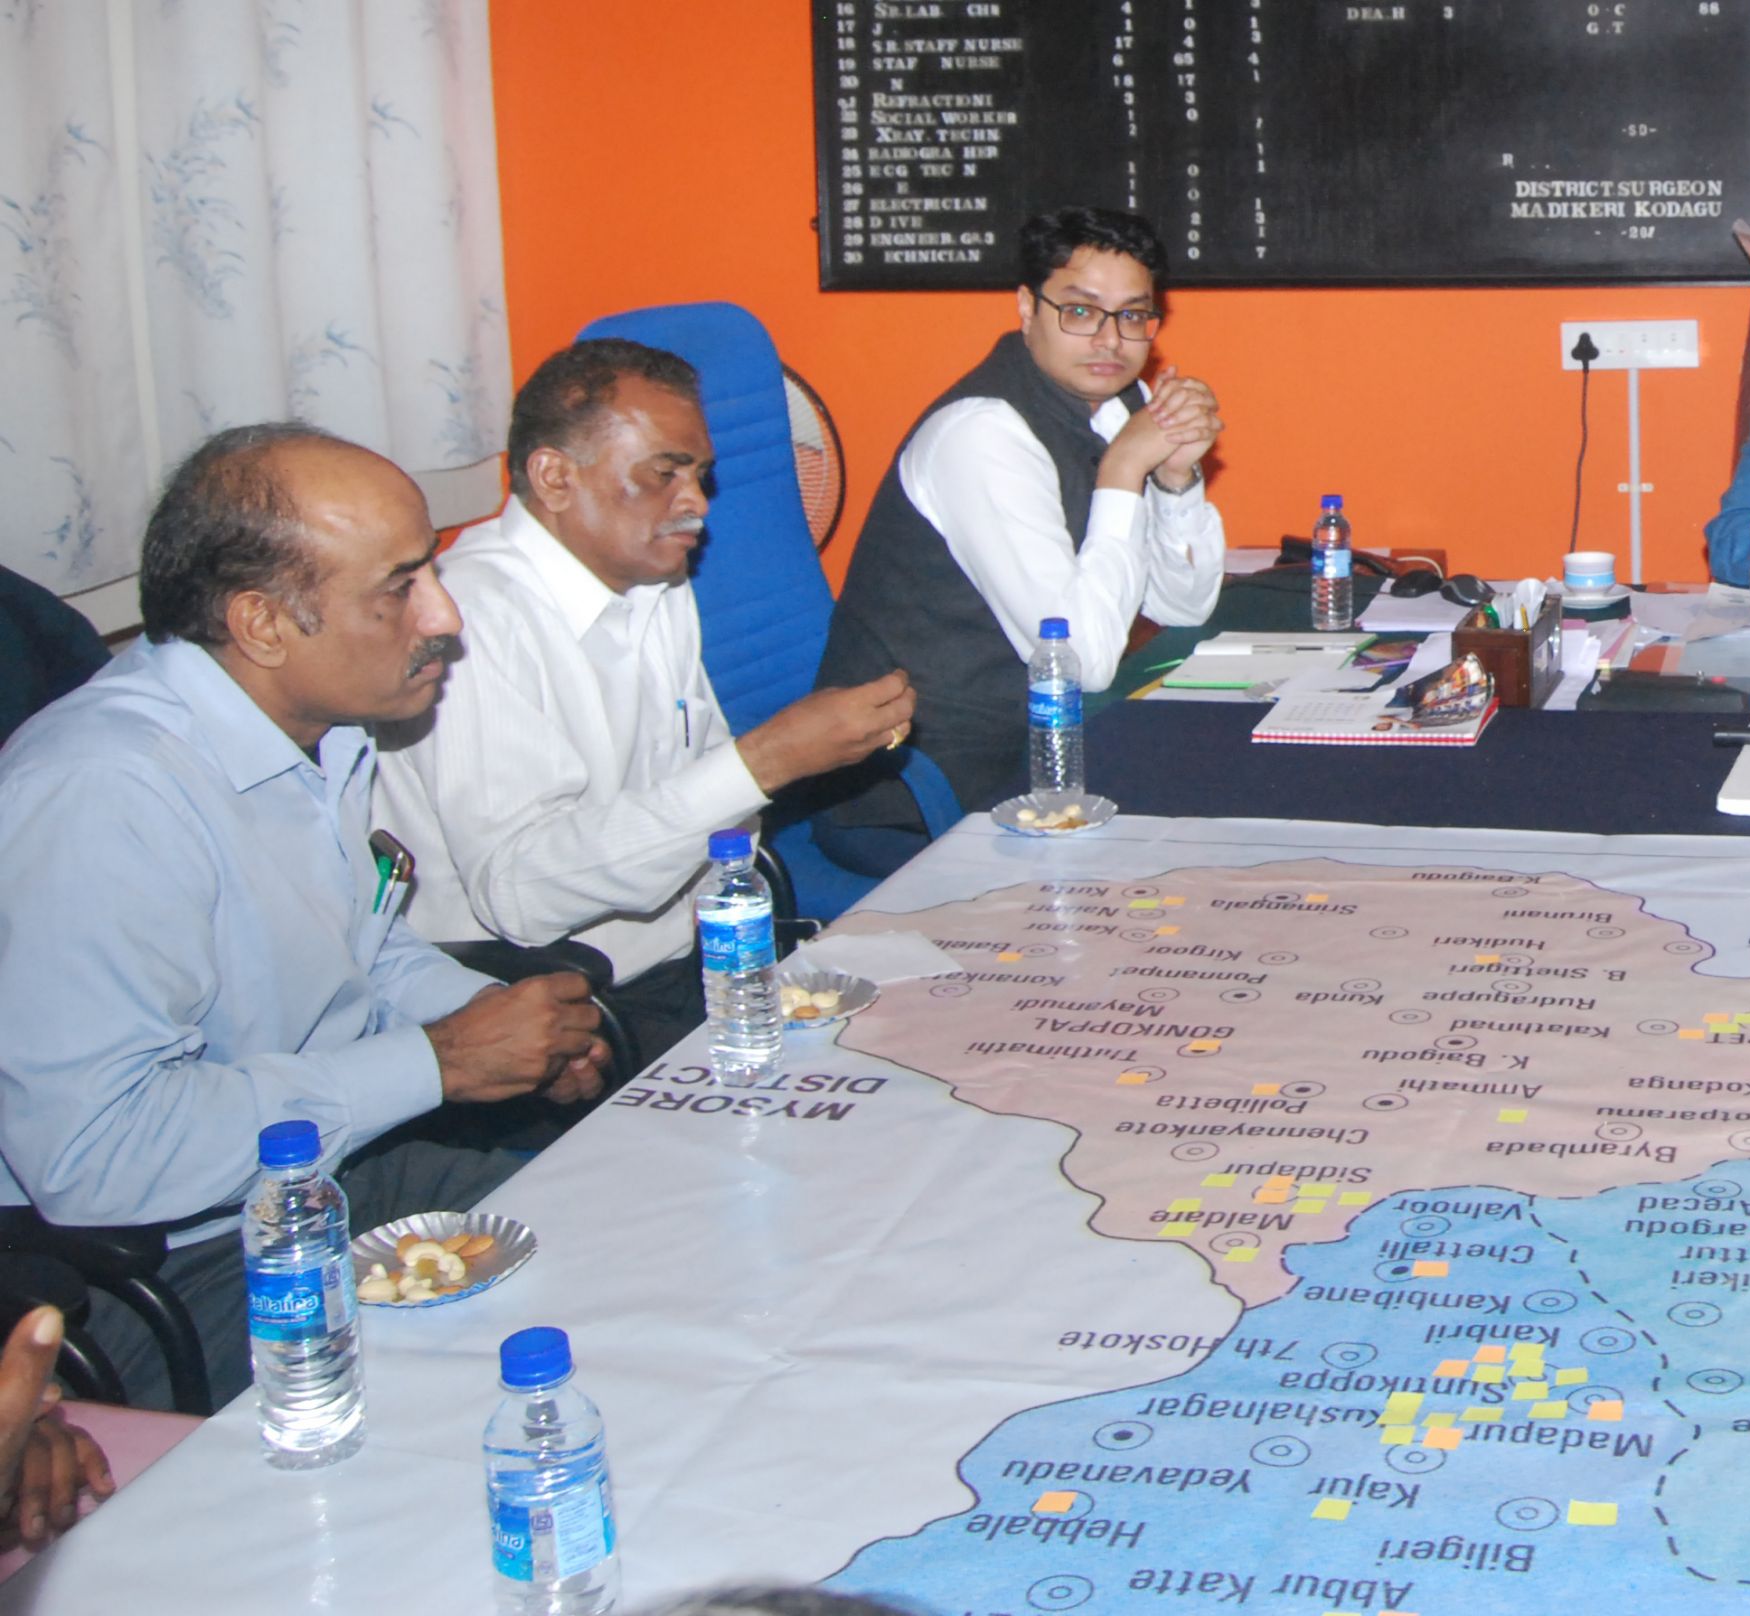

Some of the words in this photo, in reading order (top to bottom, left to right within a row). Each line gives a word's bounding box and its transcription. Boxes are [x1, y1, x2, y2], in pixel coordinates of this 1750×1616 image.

[837, 3, 855, 16] 16
[837, 20, 855, 33] 17
[837, 37, 855, 51] 18
[964, 38, 1022, 52] NURSE
[1115, 36, 1134, 49] 17
[838, 57, 856, 71] 19
[940, 56, 1001, 69] NURSE
[840, 75, 859, 89] 20
[1123, 91, 1134, 105] 3
[871, 110, 937, 125] SOCIAL
[941, 112, 1017, 124] WORKER
[1186, 108, 1198, 121] 0
[1129, 123, 1137, 136] 2
[842, 165, 862, 179] 25
[869, 164, 908, 178] ECG
[1187, 164, 1199, 177] 0
[843, 182, 863, 196] 26
[1515, 180, 1614, 198] DISTRICT
[1618, 180, 1723, 197] SURGEON
[843, 199, 860, 212] 27
[870, 197, 987, 211] ELECTRICIAN
[1511, 201, 1626, 218] MADIKERI
[1634, 201, 1722, 217] KODAGU
[843, 216, 863, 229] 28
[843, 233, 863, 246] 29
[1187, 229, 1200, 243] 0
[843, 251, 863, 264] 30
[884, 249, 980, 263] ECHNICIAN
[1187, 247, 1200, 260] 0
[1039, 884, 1109, 898] Kutta
[1211, 898, 1358, 916] Srimangala
[1502, 909, 1613, 924] Birunani
[1432, 936, 1545, 951] Hudikeri
[1145, 945, 1241, 963] Kirgoor
[1110, 966, 1267, 985] Ponnampet
[1447, 963, 1589, 981] Shettigeri
[1603, 969, 1626, 982] B.
[1295, 991, 1384, 1006] Kunda
[1421, 990, 1596, 1011] Rudraguppe
[1010, 999, 1164, 1018] Mayamudi
[1033, 1016, 1236, 1040] GONIKOPPAL
[1450, 1018, 1611, 1039] Kalathmad
[1361, 1047, 1486, 1067] Baigodu
[1502, 1055, 1529, 1070] K.
[1396, 1077, 1542, 1100] Ammathi
[611, 1087, 856, 1121] MYSORE
[1157, 1094, 1308, 1115] Pollibetta
[1115, 1120, 1370, 1146] Chennayankote
[1486, 1141, 1677, 1165] Byrambada
[1220, 1160, 1373, 1184] Siddapur
[1392, 1199, 1524, 1221] Valnoor
[1149, 1209, 1296, 1231] Maldare
[1378, 1240, 1535, 1265] Chettalli
[1304, 1285, 1512, 1314] Kambibane
[1057, 1331, 1226, 1358] Hoskote
[1423, 1323, 1561, 1348] Kanbril
[1235, 1336, 1299, 1361] 7th
[1278, 1368, 1510, 1405] Suntikoppa
[1463, 1421, 1654, 1458] Madapur
[1001, 1460, 1251, 1495] Yedavanadu
[1306, 1473, 1422, 1509] Kajur
[964, 1514, 1146, 1549] Hebbale
[1374, 1535, 1537, 1573] Biligeri
[1128, 1568, 1255, 1604] Katte
[1271, 1573, 1414, 1610] Abbur
